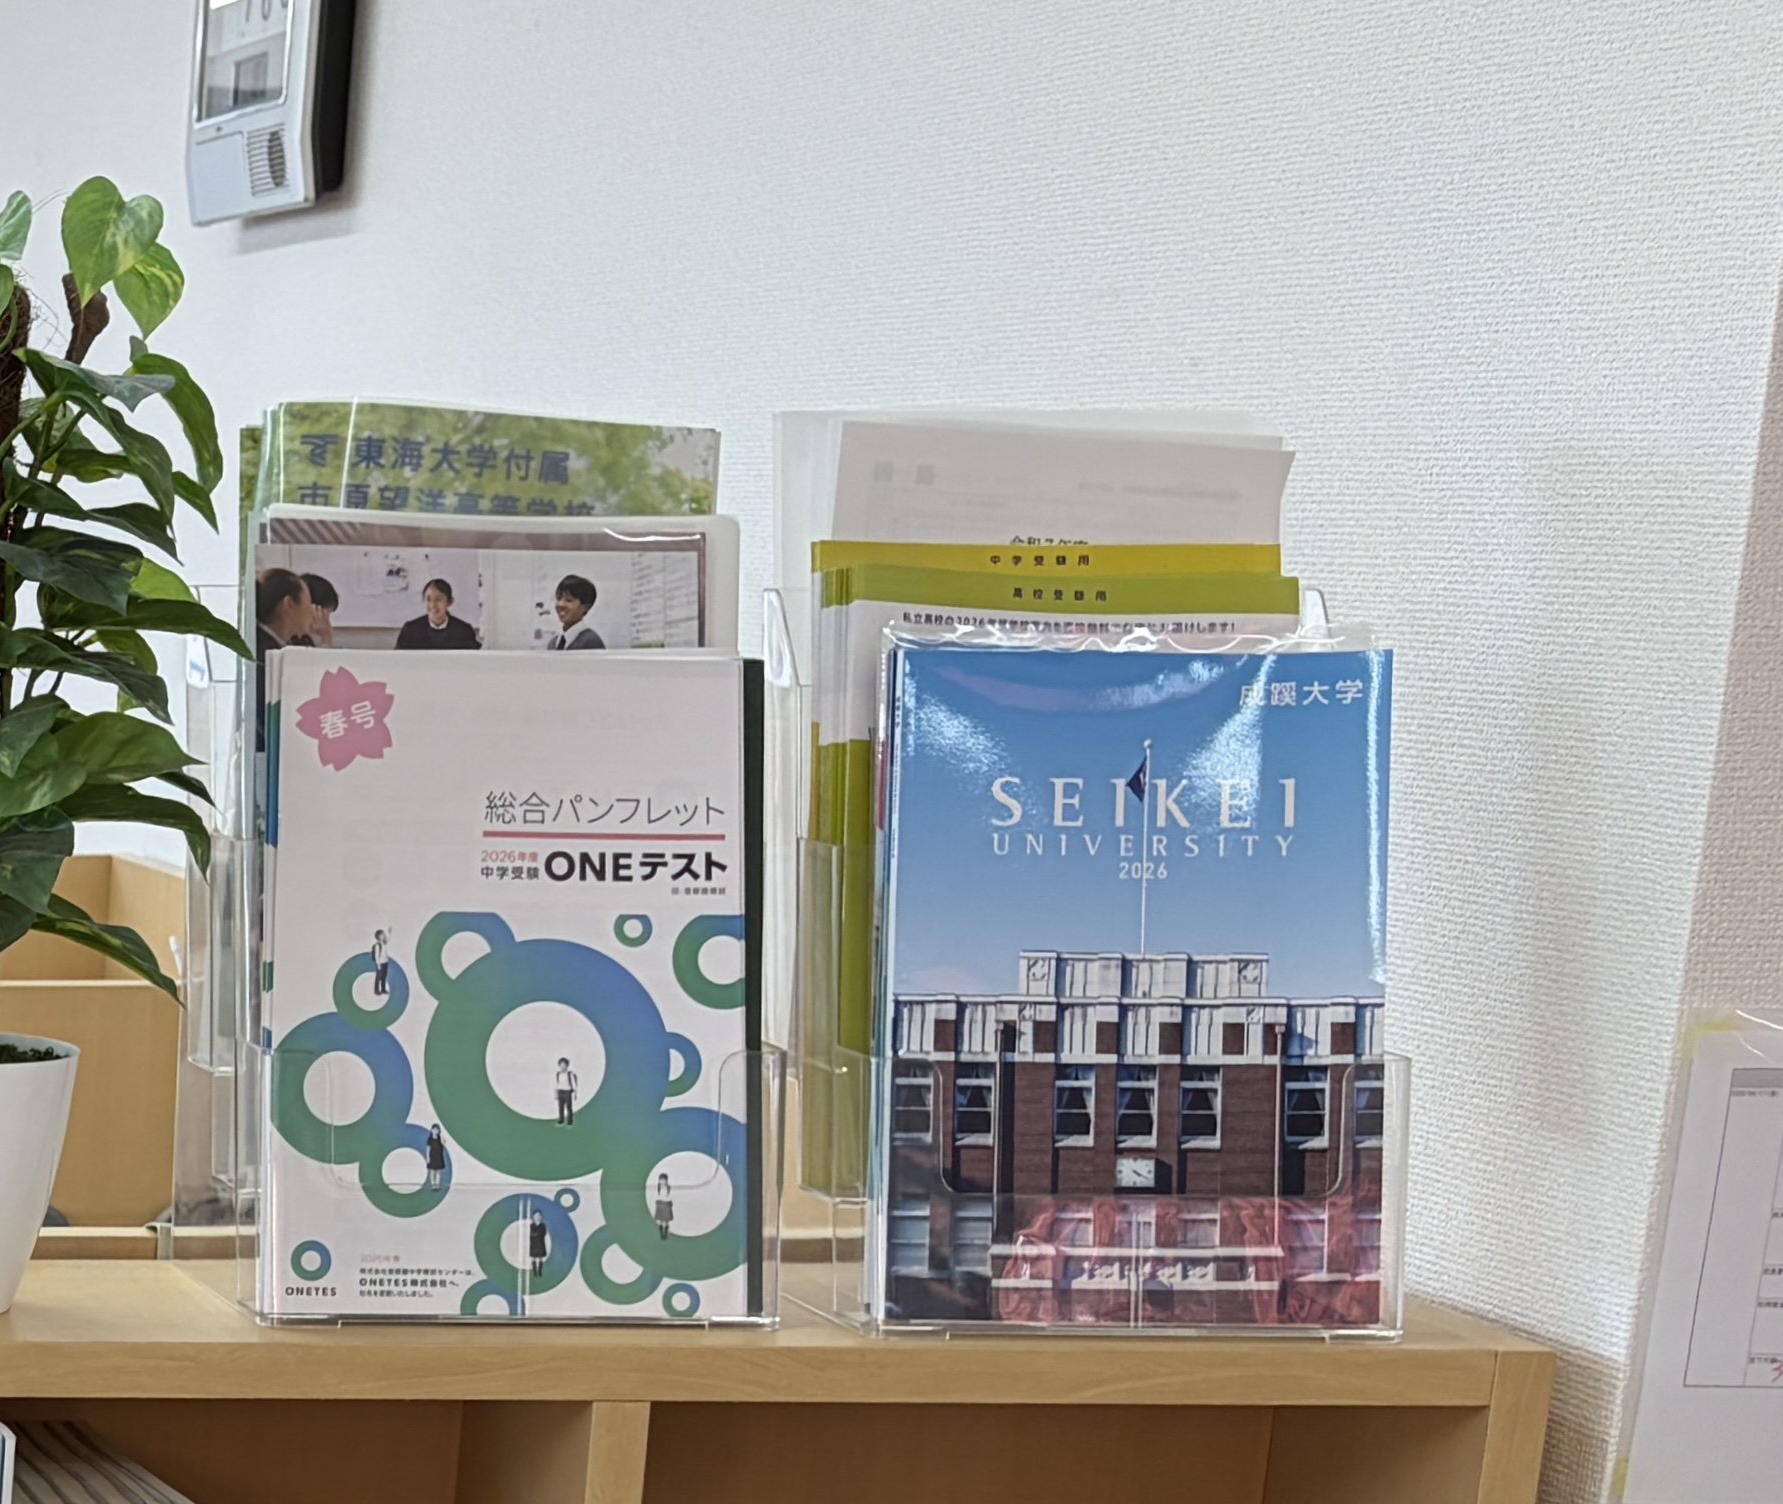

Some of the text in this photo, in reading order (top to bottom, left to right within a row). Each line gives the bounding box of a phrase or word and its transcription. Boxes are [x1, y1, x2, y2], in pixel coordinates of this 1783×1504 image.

[354, 434, 570, 485] 東海大学付属
[319, 700, 376, 739] 春号
[484, 791, 725, 826] 総合パンフレット
[991, 776, 1296, 828] SEIKEI
[993, 833, 1296, 857] UNIVERSITY
[481, 866, 539, 880] 中学受験
[544, 851, 728, 882] ONEテスト
[1119, 862, 1168, 879] 2026
